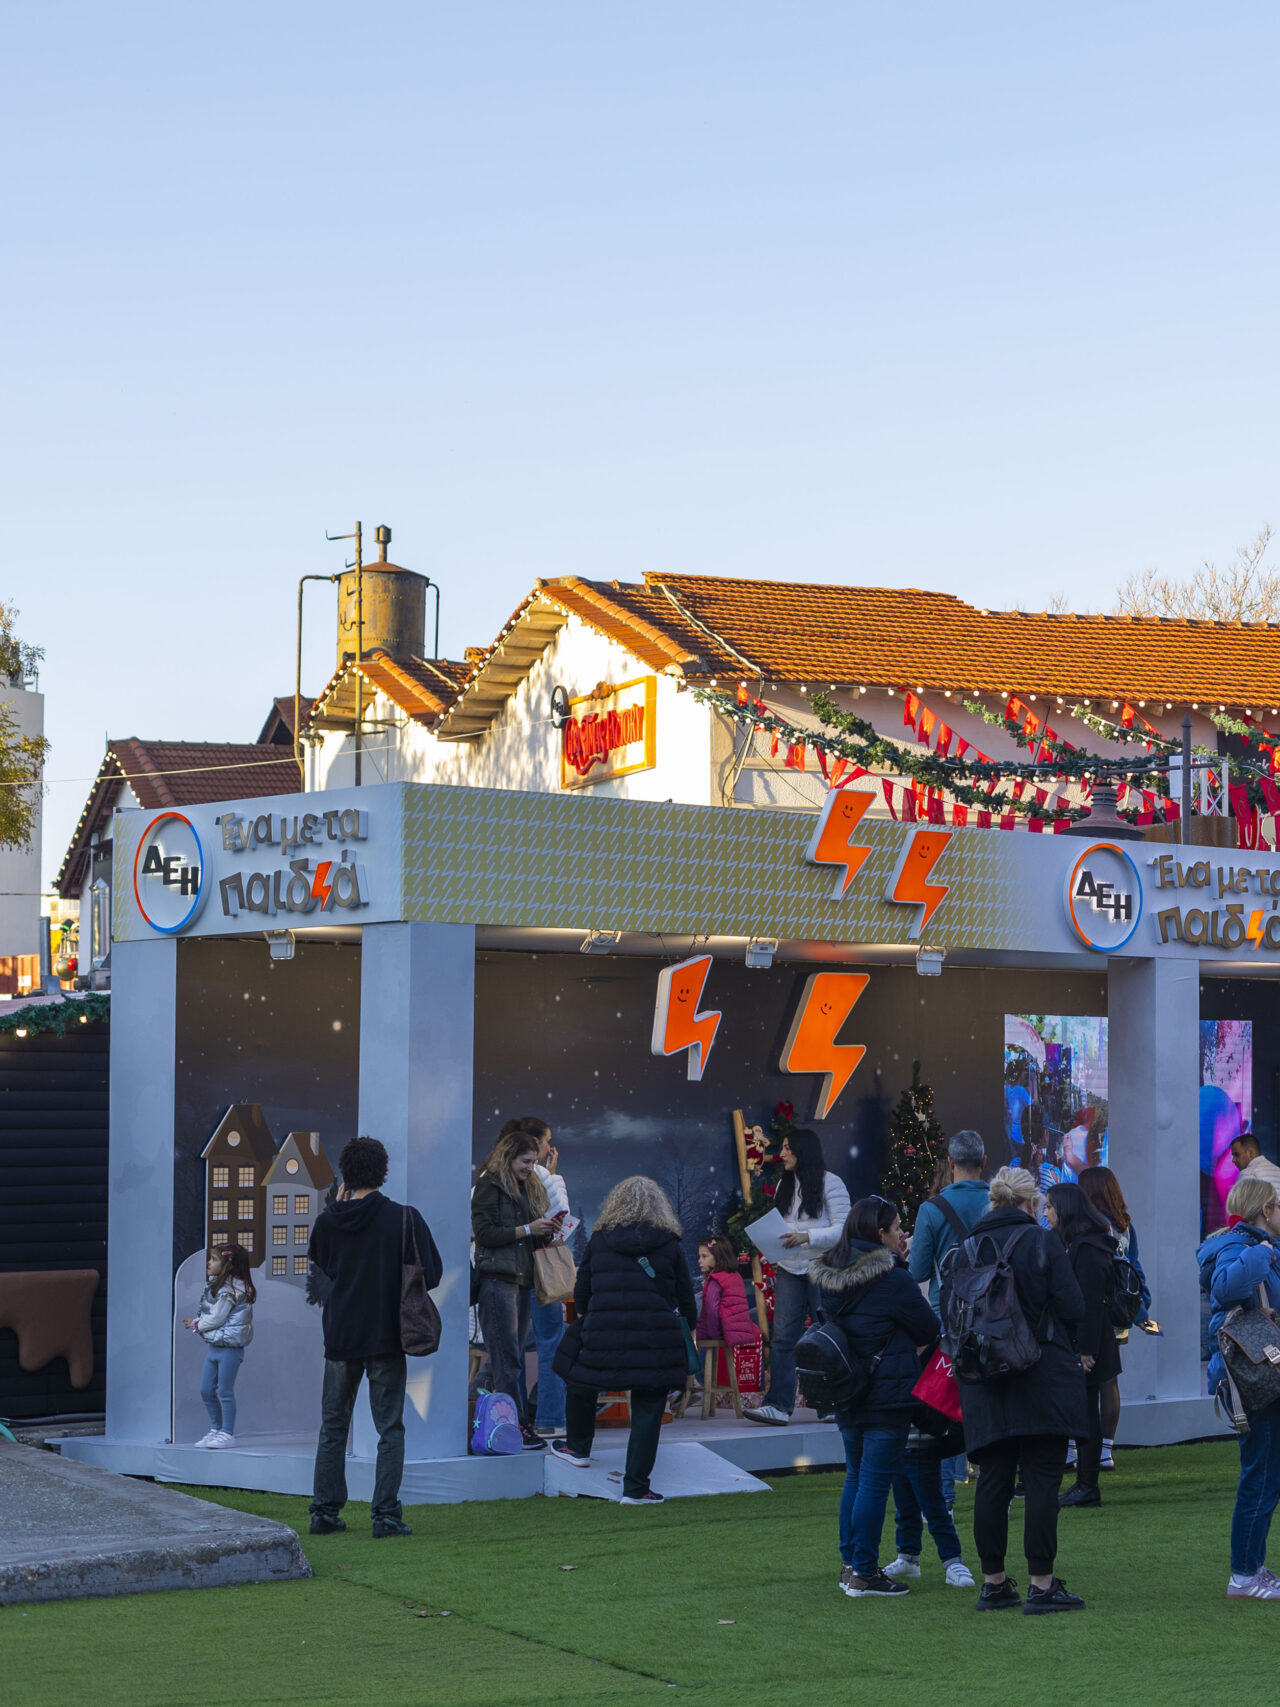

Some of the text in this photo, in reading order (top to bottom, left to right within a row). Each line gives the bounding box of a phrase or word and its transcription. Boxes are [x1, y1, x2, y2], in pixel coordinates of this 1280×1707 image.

[216, 812, 274, 851] Ένα
[142, 845, 200, 896] ΔΕΗ
[1153, 855, 1211, 888] Ένα
[1075, 871, 1132, 920] ΔΕΗ
